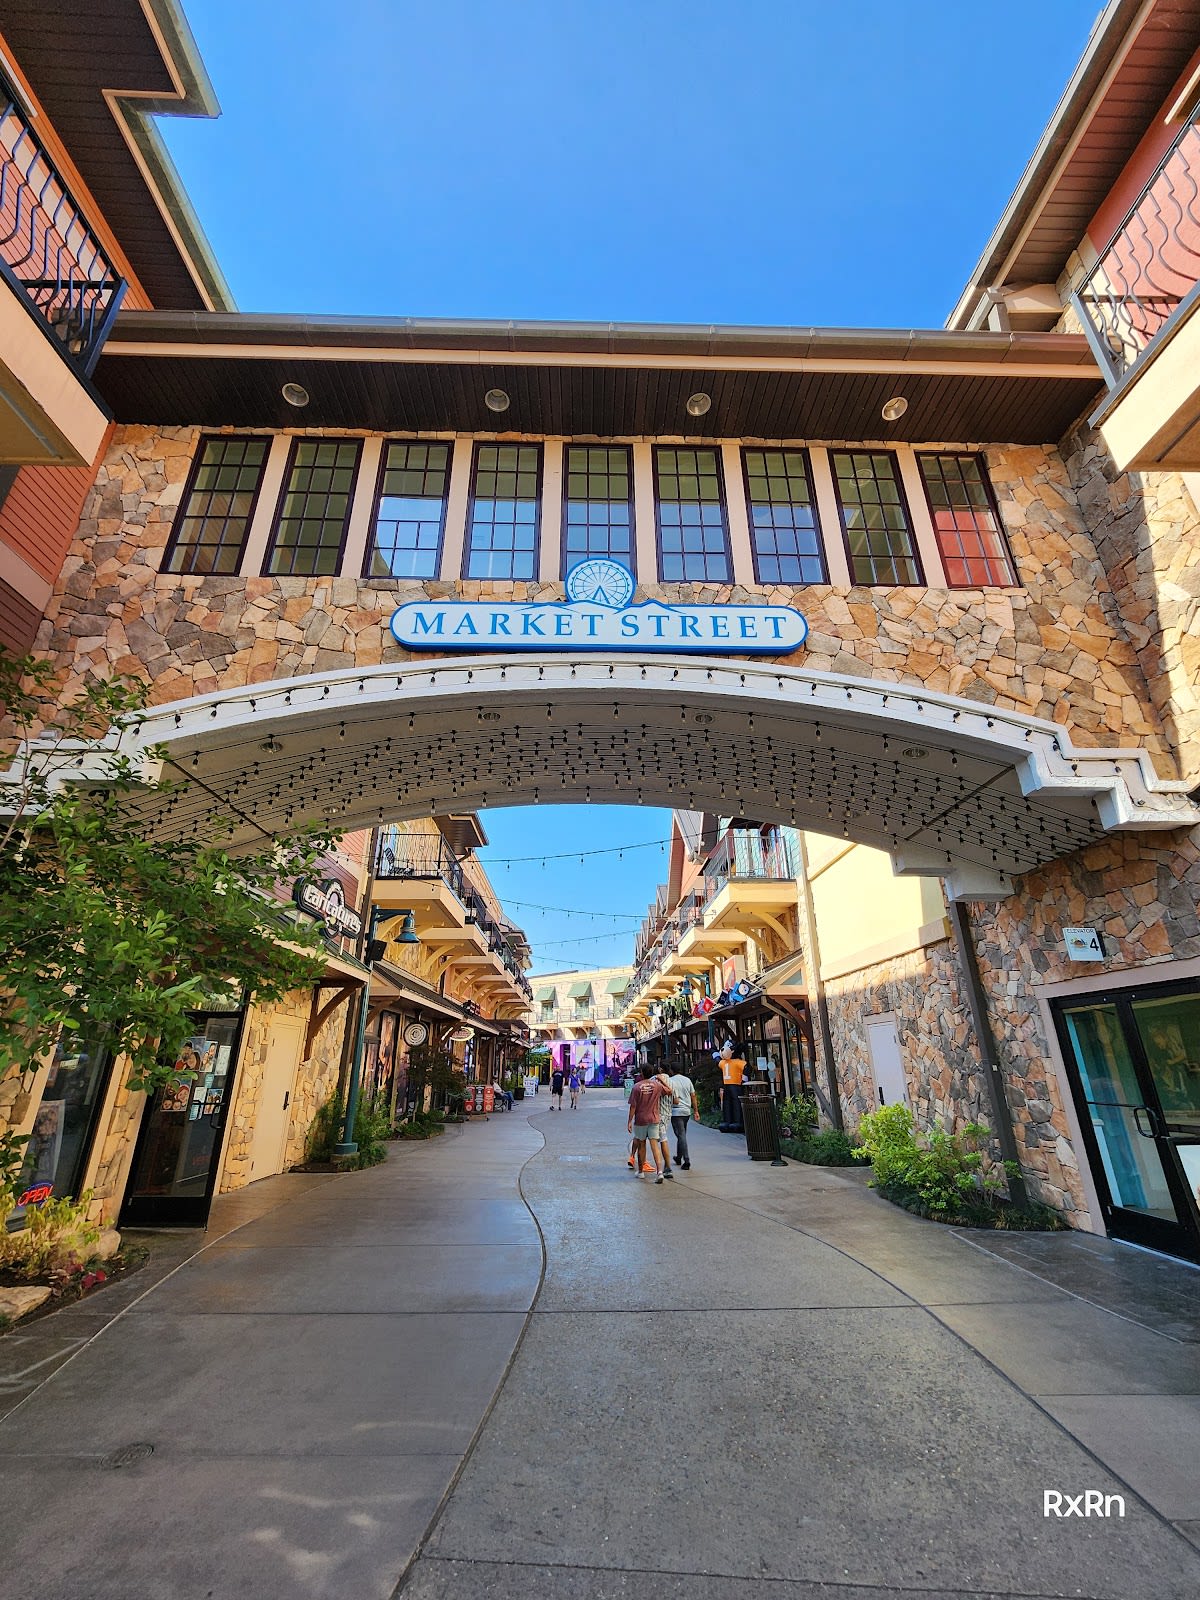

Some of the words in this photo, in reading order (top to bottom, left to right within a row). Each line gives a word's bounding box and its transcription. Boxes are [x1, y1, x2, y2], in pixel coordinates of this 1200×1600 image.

[411, 612, 604, 636] MARKET
[621, 614, 787, 638] STREET
[1090, 937, 1099, 951] 4
[723, 1062, 731, 1080] 1
[17, 1185, 54, 1206] OPEN
